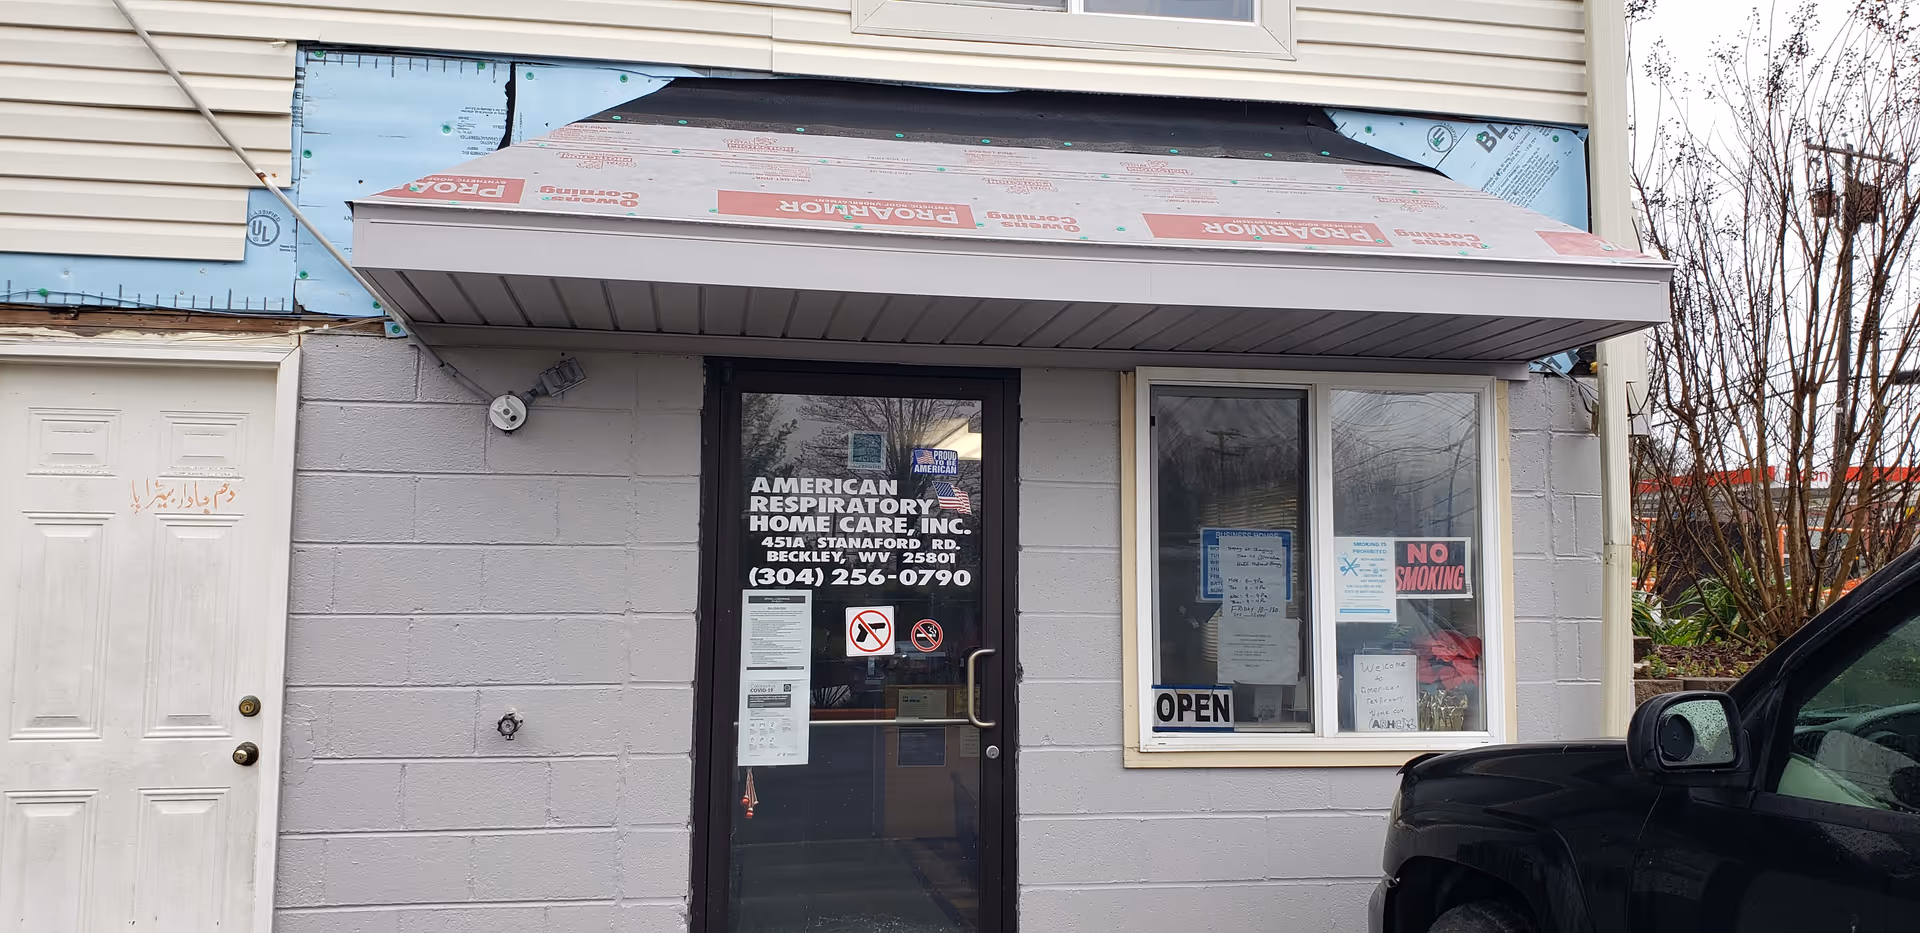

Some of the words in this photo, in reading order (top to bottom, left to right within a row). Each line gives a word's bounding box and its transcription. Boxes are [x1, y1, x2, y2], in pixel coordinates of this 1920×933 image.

[540, 186, 639, 200] Corning
[551, 196, 639, 208] Owens
[986, 211, 1077, 224] Corning
[251, 219, 271, 243] UL
[1001, 221, 1081, 233] Owens
[1394, 228, 1481, 242] Corning
[933, 450, 957, 461] PROUD
[914, 465, 958, 475] AMERICAN
[751, 477, 898, 496] AMERICAN
[750, 496, 935, 515] RESPIRATORY
[750, 515, 830, 533] HOME
[839, 516, 916, 536] CARE,
[921, 518, 972, 535] INC.
[761, 537, 806, 549] 451A
[817, 537, 922, 550] STANAFORD
[932, 539, 961, 550] RD.
[766, 551, 846, 565] BECKLEY,
[859, 551, 891, 563] WV
[902, 552, 956, 564] 25801
[1407, 543, 1448, 564] NO
[749, 567, 824, 587] (304)
[831, 568, 972, 587] 256-0790
[1394, 565, 1464, 591] SMOKING
[1156, 692, 1231, 723] OPEN
